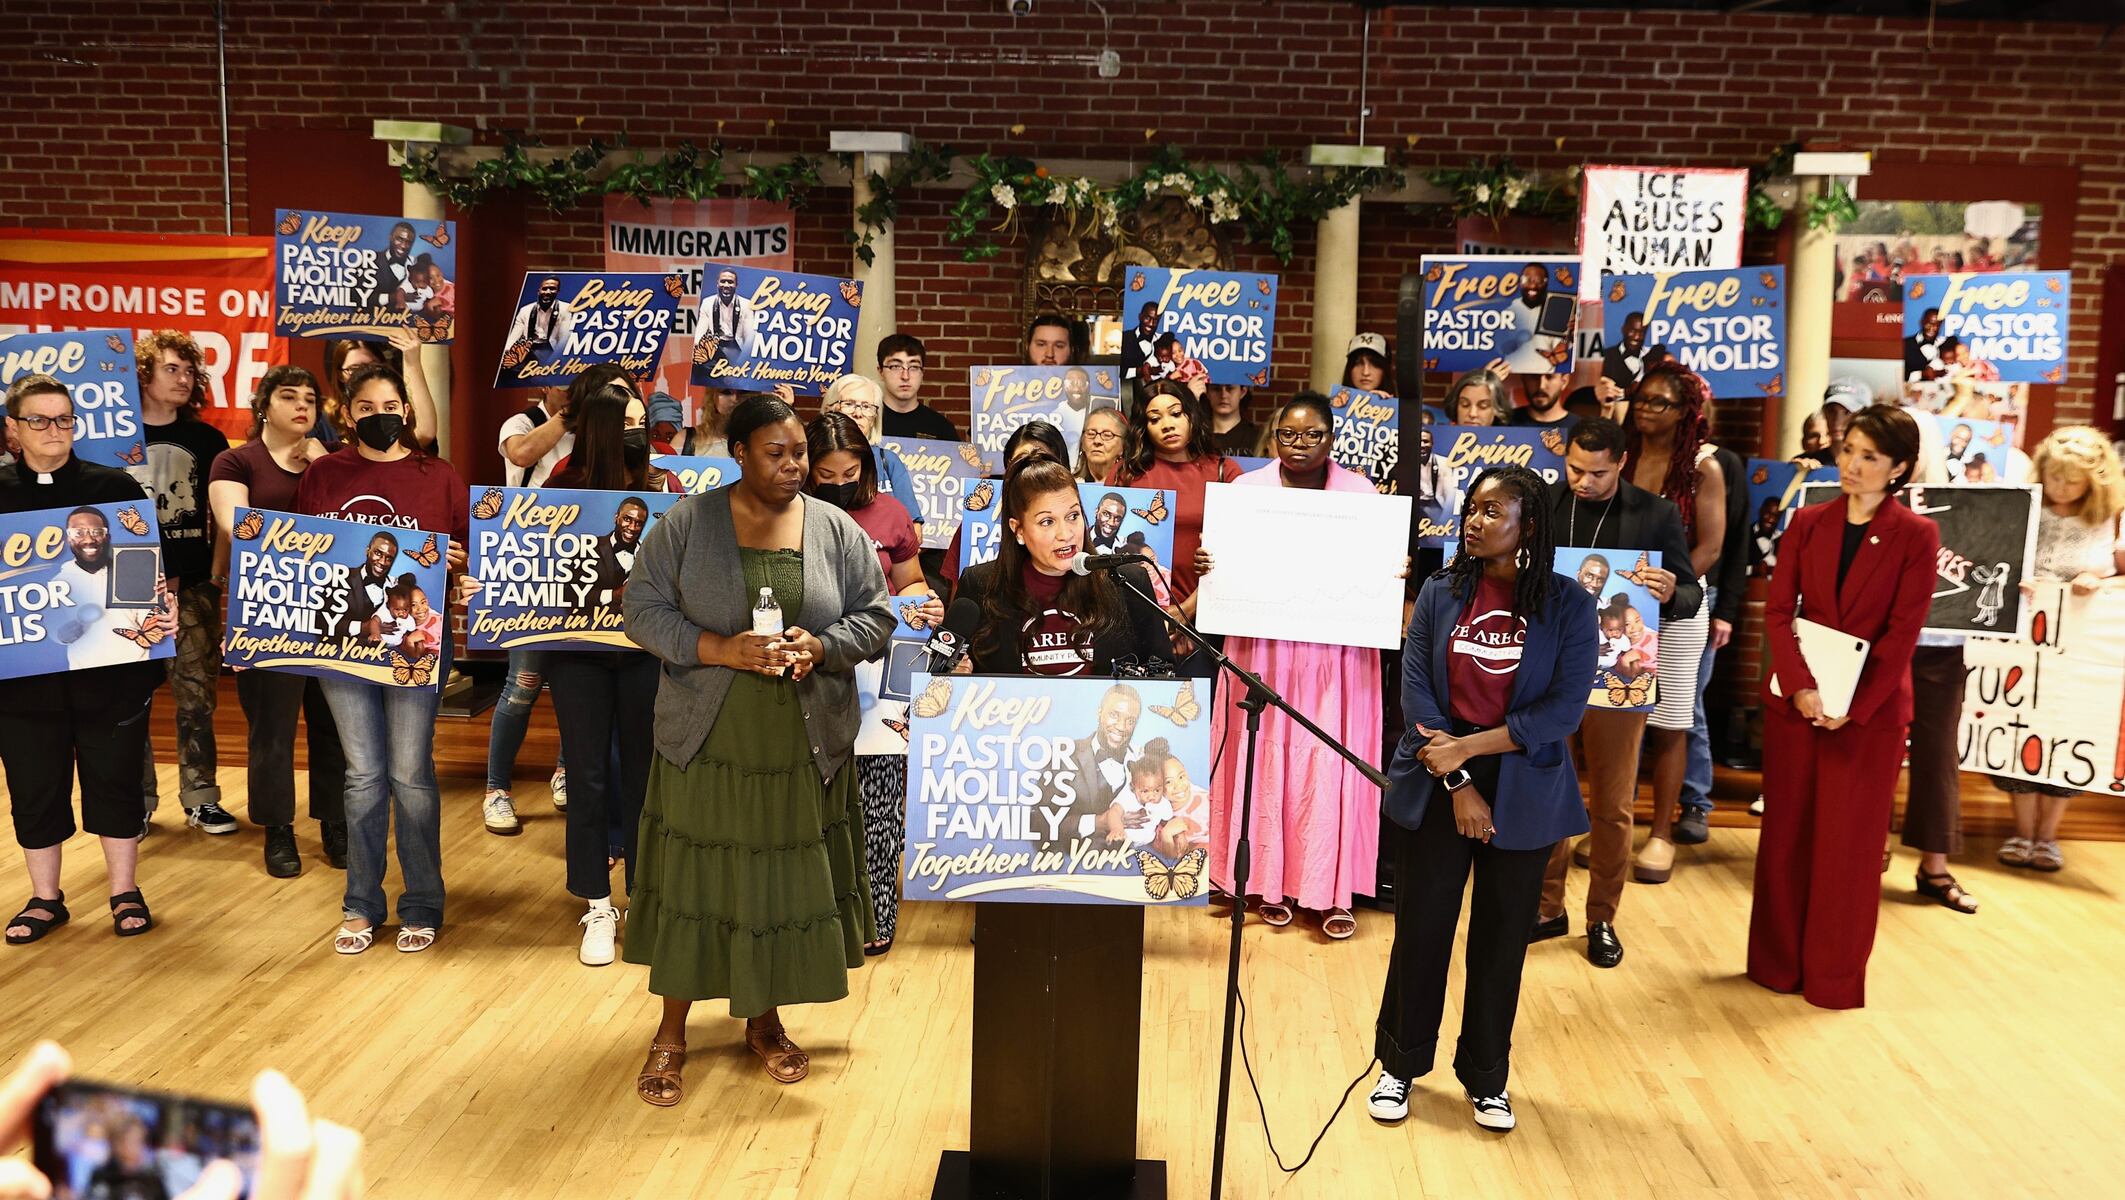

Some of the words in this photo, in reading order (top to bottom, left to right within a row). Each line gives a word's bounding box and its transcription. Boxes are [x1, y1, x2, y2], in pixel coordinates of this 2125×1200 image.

[1638, 171, 1686, 199] ICE
[301, 215, 363, 251] Keep
[1602, 200, 1724, 233] ABUSES
[283, 244, 379, 270] PASTOR
[611, 225, 787, 257] IMMIGRANTS
[1606, 234, 1713, 267] HUMAN
[282, 265, 378, 289] MOLIS'S
[1156, 268, 1241, 316] Free
[1432, 263, 1519, 308] Free
[219, 289, 269, 318] ON
[287, 284, 374, 307] FAMILY
[568, 279, 654, 320] Bring
[750, 276, 831, 328] Bring
[1642, 272, 1741, 327] Free
[1937, 272, 2030, 320] Free
[277, 305, 350, 333] Together
[350, 308, 370, 325] in
[372, 306, 413, 326] York
[570, 309, 670, 331] PASTOR
[753, 310, 852, 340] PASTOR
[1163, 310, 1264, 338] PASTOR
[1424, 309, 1516, 330] PASTOR
[1650, 315, 1776, 345] PASTOR
[1944, 312, 2059, 337] PASTOR
[563, 330, 662, 357] MOLIS
[751, 332, 847, 366] MOLIS
[1184, 336, 1267, 363] MOLIS
[1424, 330, 1495, 350] MOLIS
[1969, 336, 2062, 361] MOLIS
[0, 341, 85, 385] ree
[518, 360, 560, 379] Back
[620, 354, 653, 371] York
[710, 359, 751, 378] Back
[751, 361, 793, 380] Home
[794, 366, 808, 381] to
[808, 365, 842, 383] York
[1680, 342, 1780, 372] MOLIS
[983, 368, 1063, 412] Free
[1346, 394, 1395, 428] Keep
[344, 512, 377, 525] ARE
[379, 514, 419, 531] CASA
[502, 492, 580, 535] Keep
[261, 518, 334, 562] Keep
[480, 531, 600, 559] PASTOR
[239, 551, 352, 589] PASTOR
[478, 557, 599, 583] MOLIS'S
[237, 576, 349, 613] MOLIS'S
[484, 581, 594, 608] FAMILY
[241, 601, 344, 636] FAMILY
[470, 609, 562, 643] Together
[564, 608, 588, 630] in
[591, 606, 625, 631] Yor
[227, 627, 313, 661] Together
[313, 637, 337, 657] in
[339, 637, 390, 662] York
[1473, 630, 1512, 645] ARE
[1964, 651, 2040, 709] ruel
[951, 681, 1051, 739] Keep
[922, 733, 1078, 771] PASTOR
[920, 768, 1077, 807] MOLIS'S
[926, 804, 1070, 841] FAMILY
[907, 842, 1029, 891] Together
[1031, 842, 1064, 872] in
[1068, 838, 1136, 874] York
